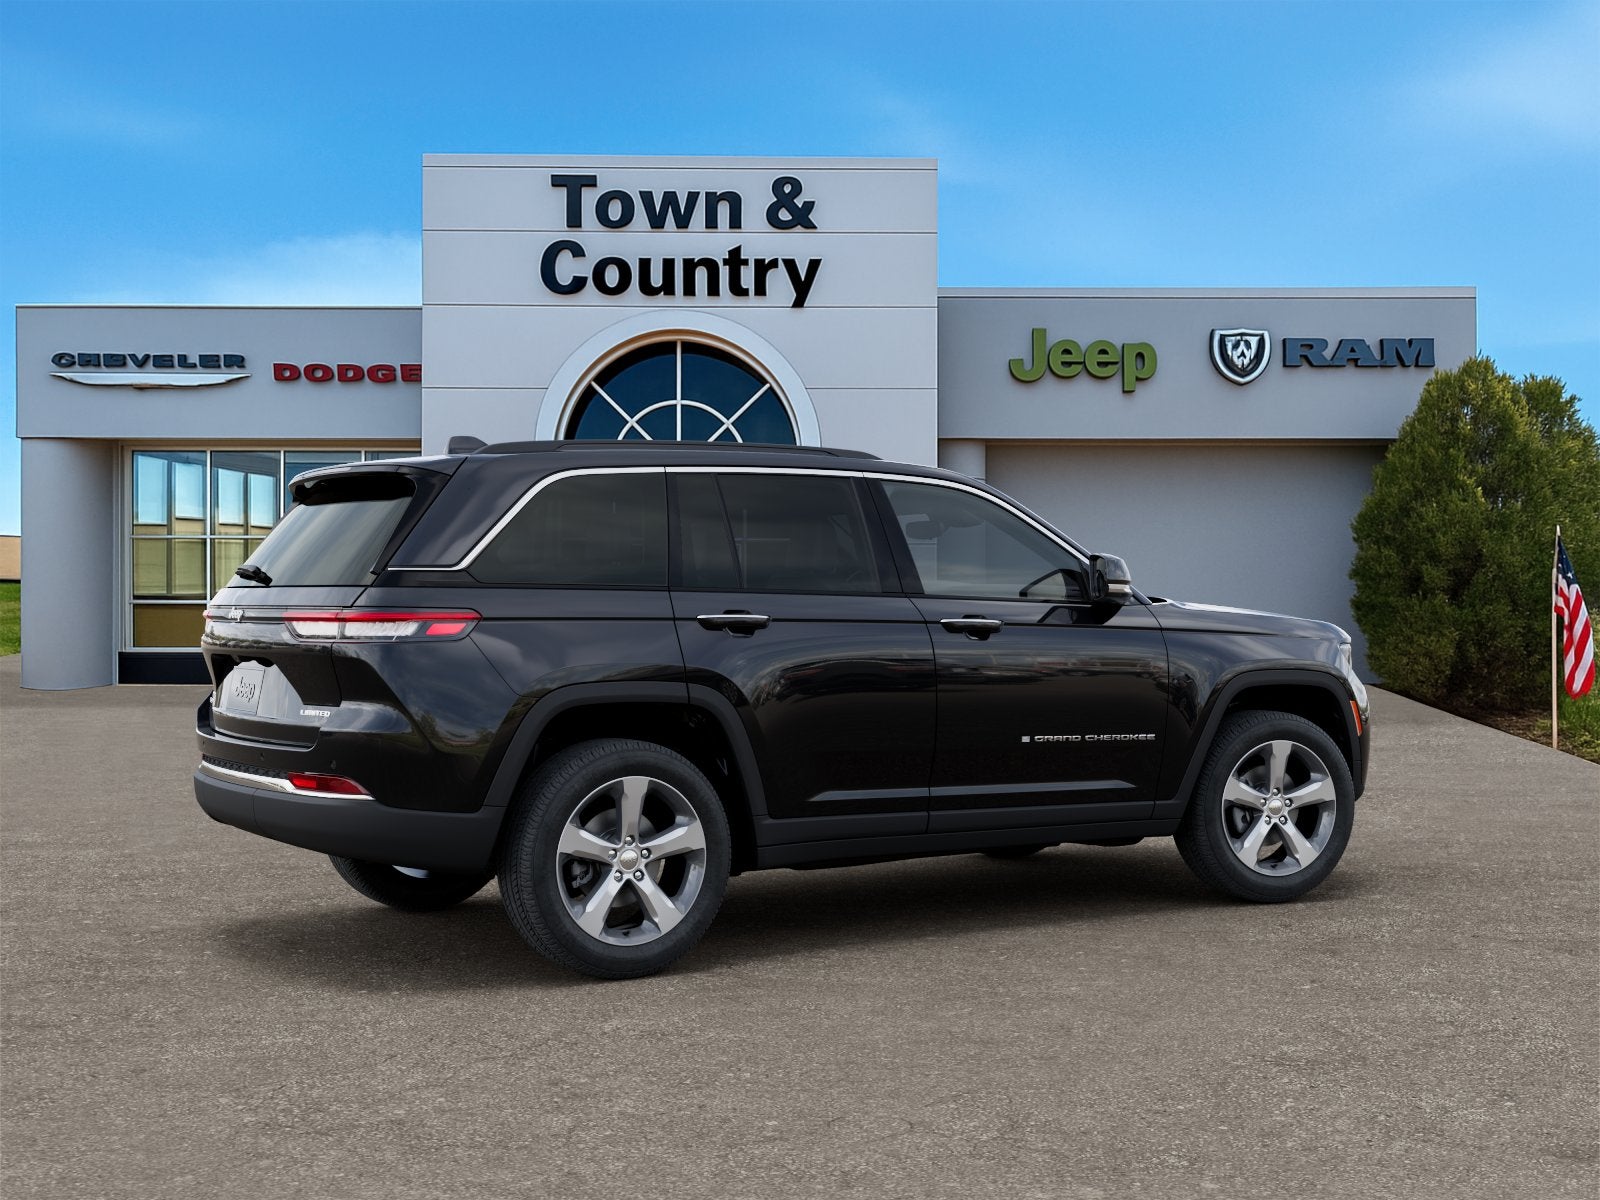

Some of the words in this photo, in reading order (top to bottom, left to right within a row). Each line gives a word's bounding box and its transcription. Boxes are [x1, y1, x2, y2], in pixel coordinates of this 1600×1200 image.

[551, 174, 742, 229] Town
[766, 176, 818, 230] &
[540, 239, 823, 308] Country
[1009, 327, 1158, 393] Jeep
[1282, 337, 1436, 368] RAM
[273, 363, 422, 383] DODGE
[300, 709, 331, 717] LIMITED
[1085, 733, 1155, 742] CHEROKEE
